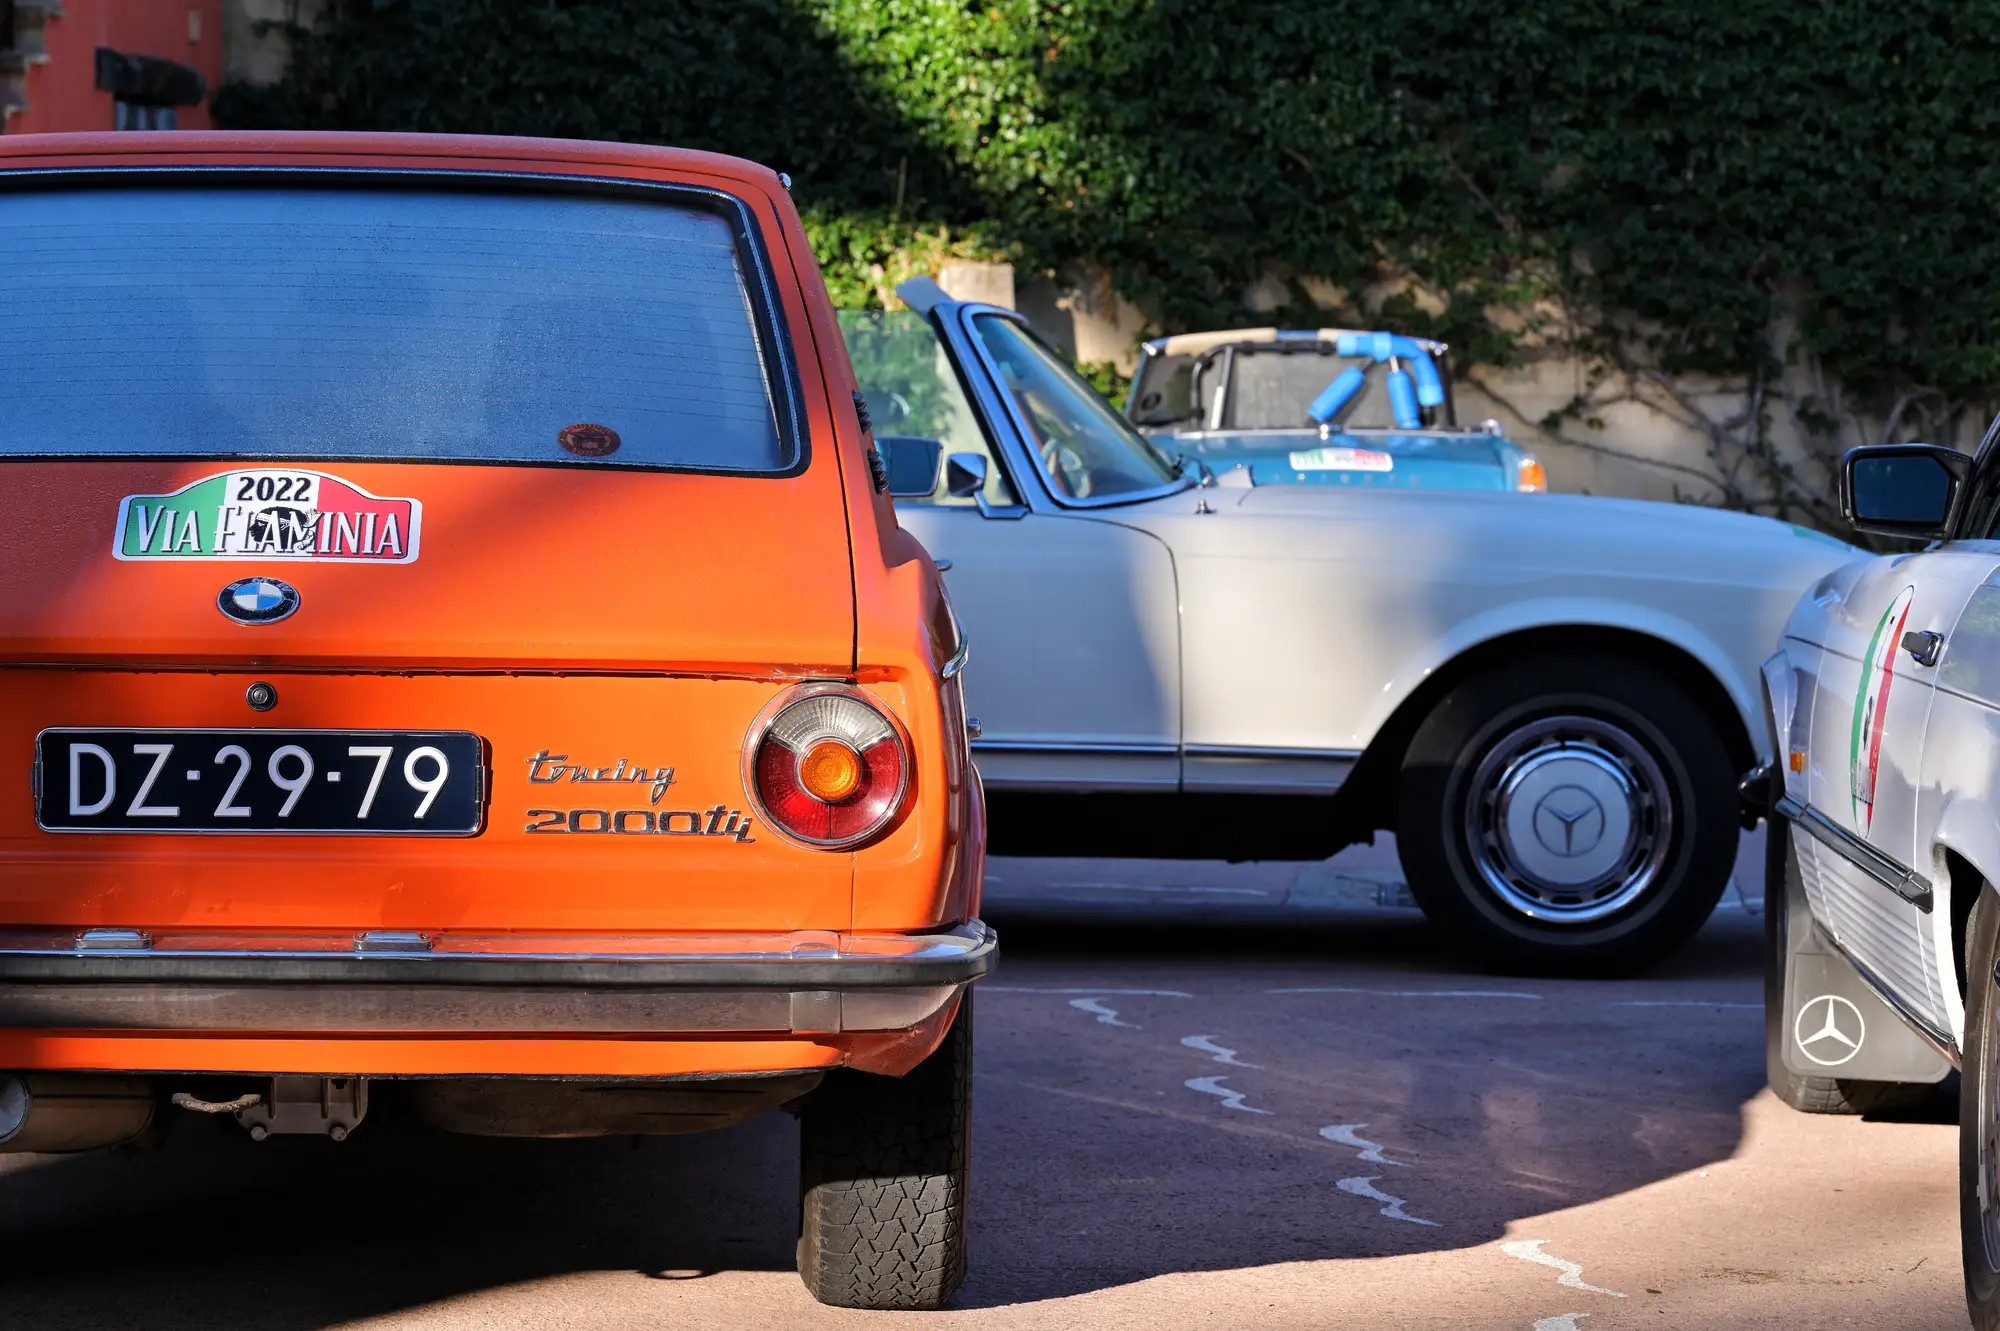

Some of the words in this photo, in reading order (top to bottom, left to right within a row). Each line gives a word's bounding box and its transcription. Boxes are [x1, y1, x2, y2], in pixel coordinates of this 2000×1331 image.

[236, 476, 311, 502] 2022
[136, 505, 202, 552] VIA
[212, 505, 404, 556] FLAMINIA
